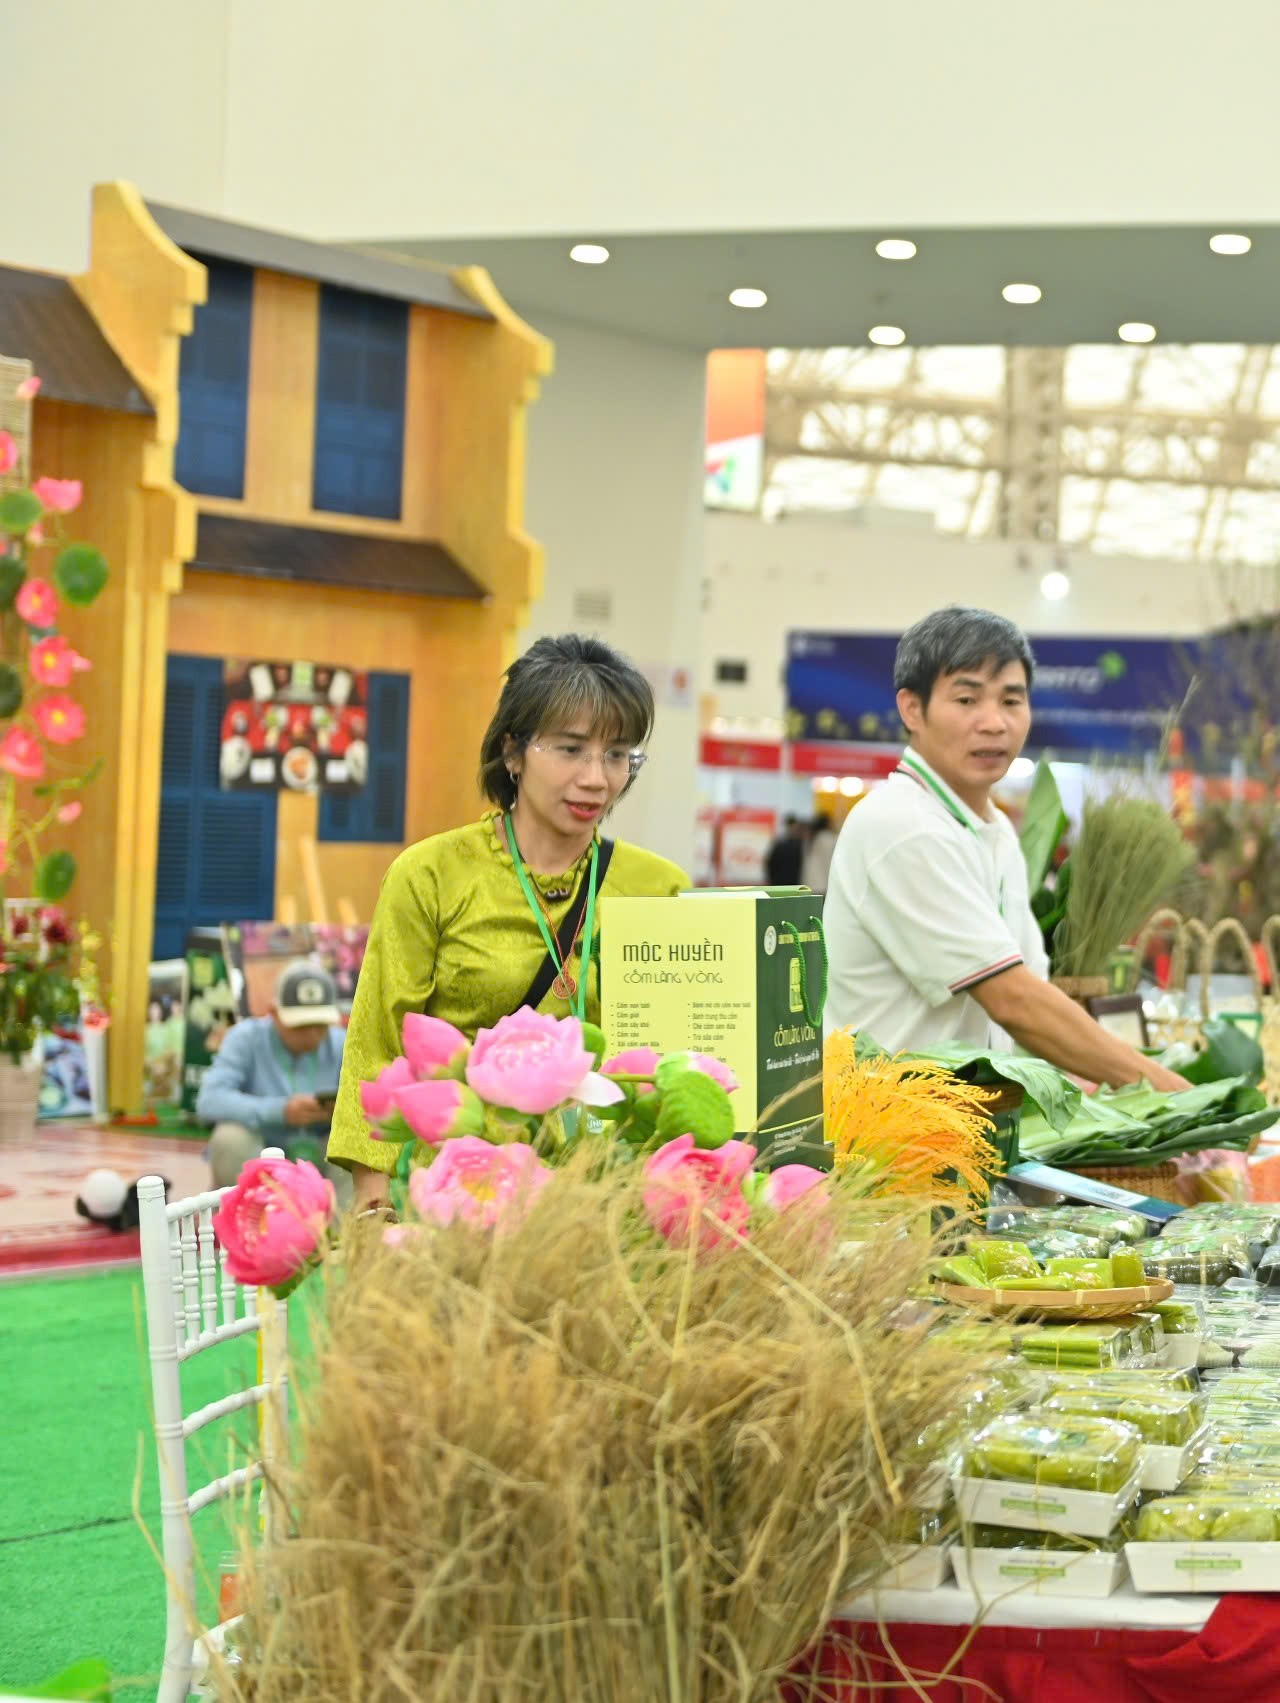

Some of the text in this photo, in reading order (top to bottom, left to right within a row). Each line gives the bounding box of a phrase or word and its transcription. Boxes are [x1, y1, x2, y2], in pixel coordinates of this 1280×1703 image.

[623, 937, 723, 964] MỘC HUYỀN
[623, 968, 723, 984] CỐM LÀNG VÒNG
